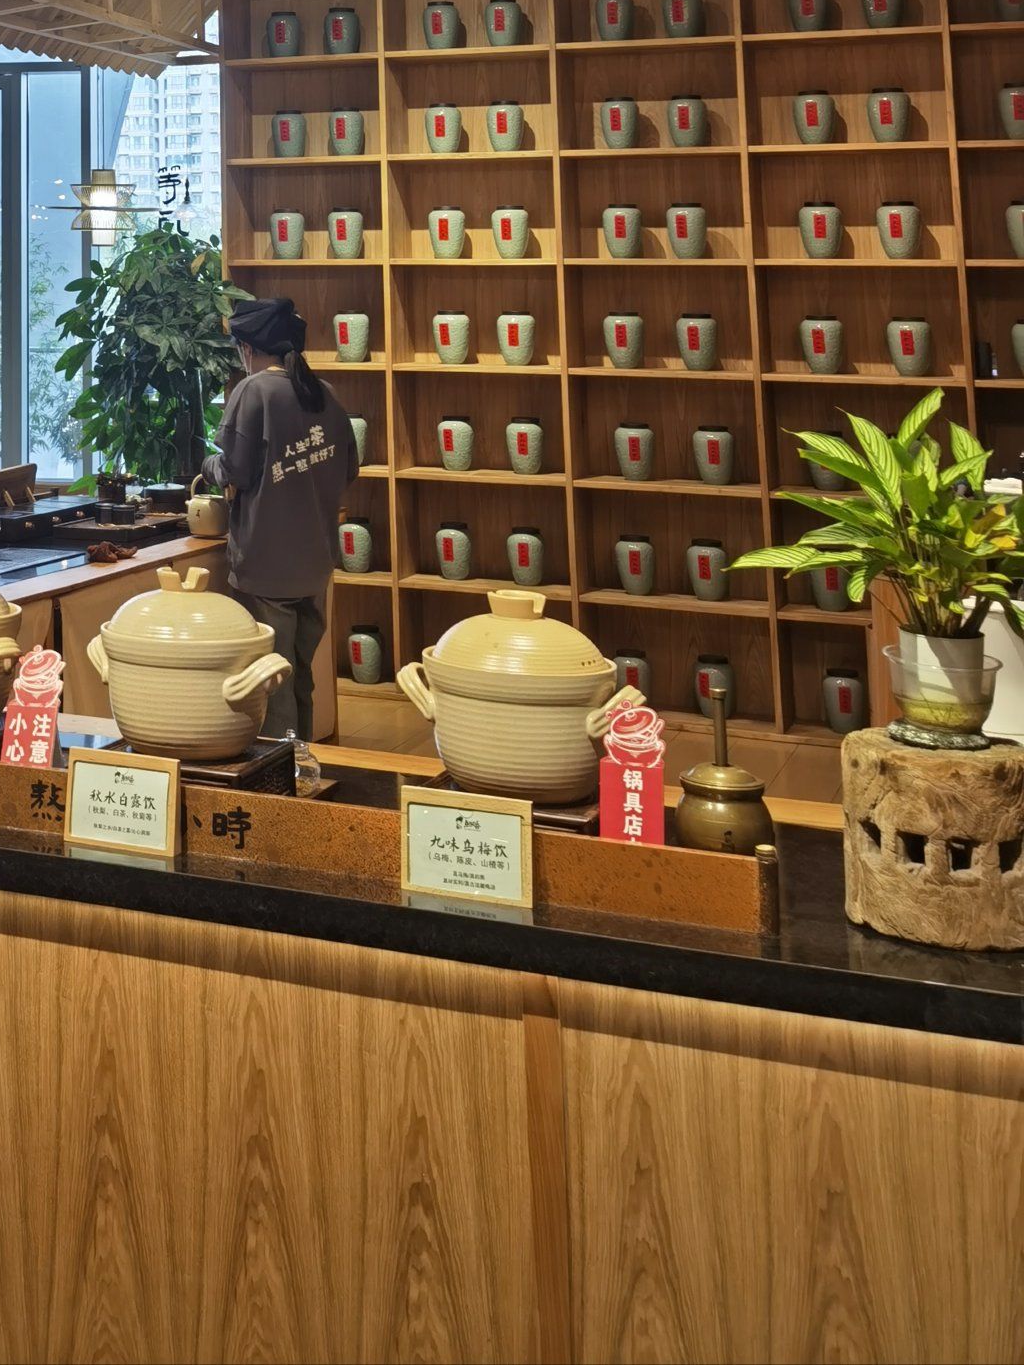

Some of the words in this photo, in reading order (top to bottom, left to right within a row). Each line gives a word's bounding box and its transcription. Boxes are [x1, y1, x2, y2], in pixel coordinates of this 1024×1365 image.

[5, 712, 28, 762] 小心
[28, 713, 52, 764] 注意
[89, 789, 157, 810] 秋水白露饮
[622, 769, 644, 845] 锅具店
[430, 835, 508, 859] 九味乌梅饮
